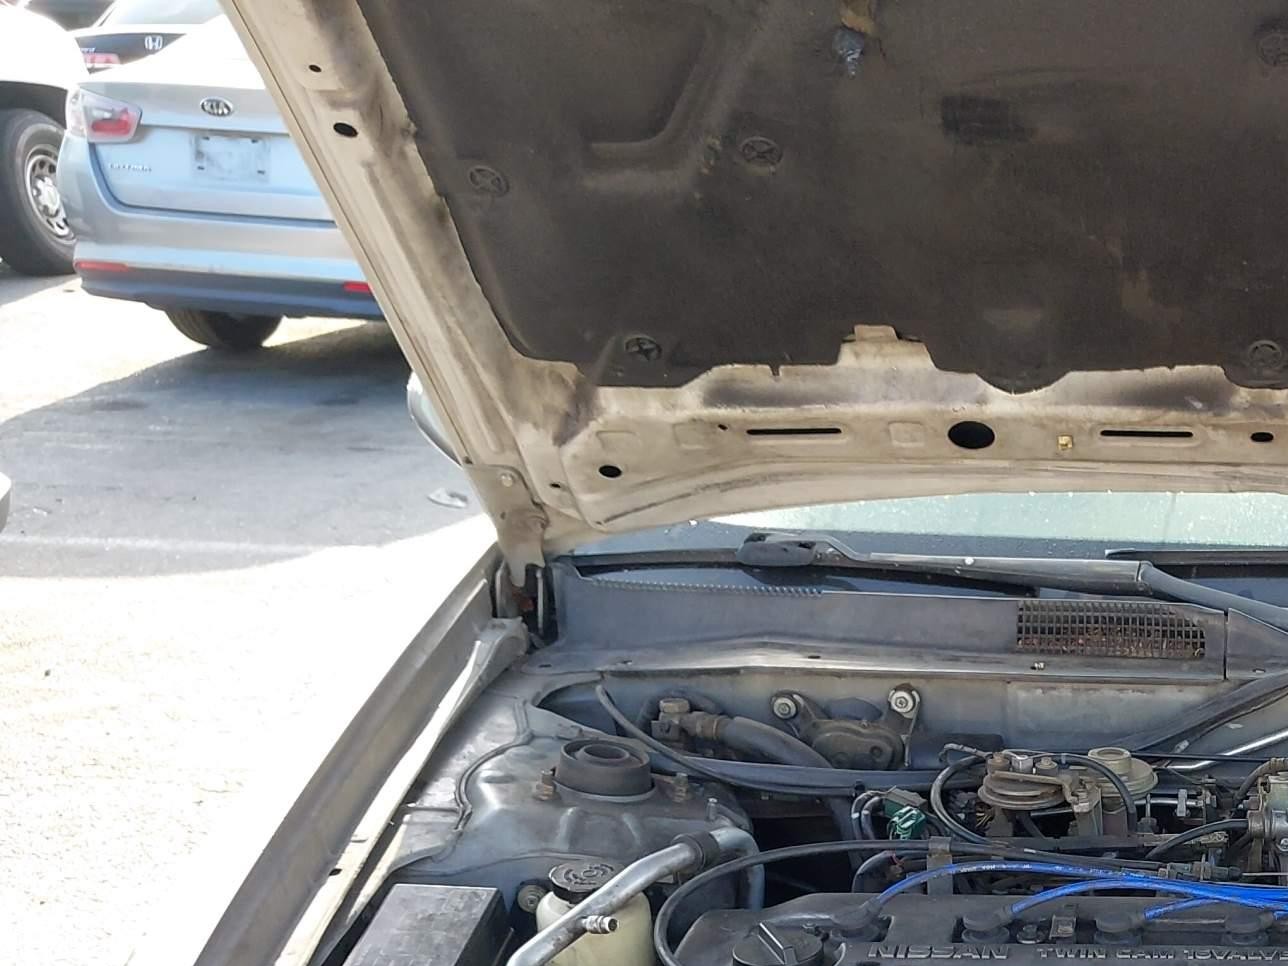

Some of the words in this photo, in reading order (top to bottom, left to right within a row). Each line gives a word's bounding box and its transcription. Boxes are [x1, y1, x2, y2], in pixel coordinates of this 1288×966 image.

[868, 945, 1009, 959] NISSAN
[1037, 948, 1106, 958] TWIN
[1116, 949, 1175, 959] CAM
